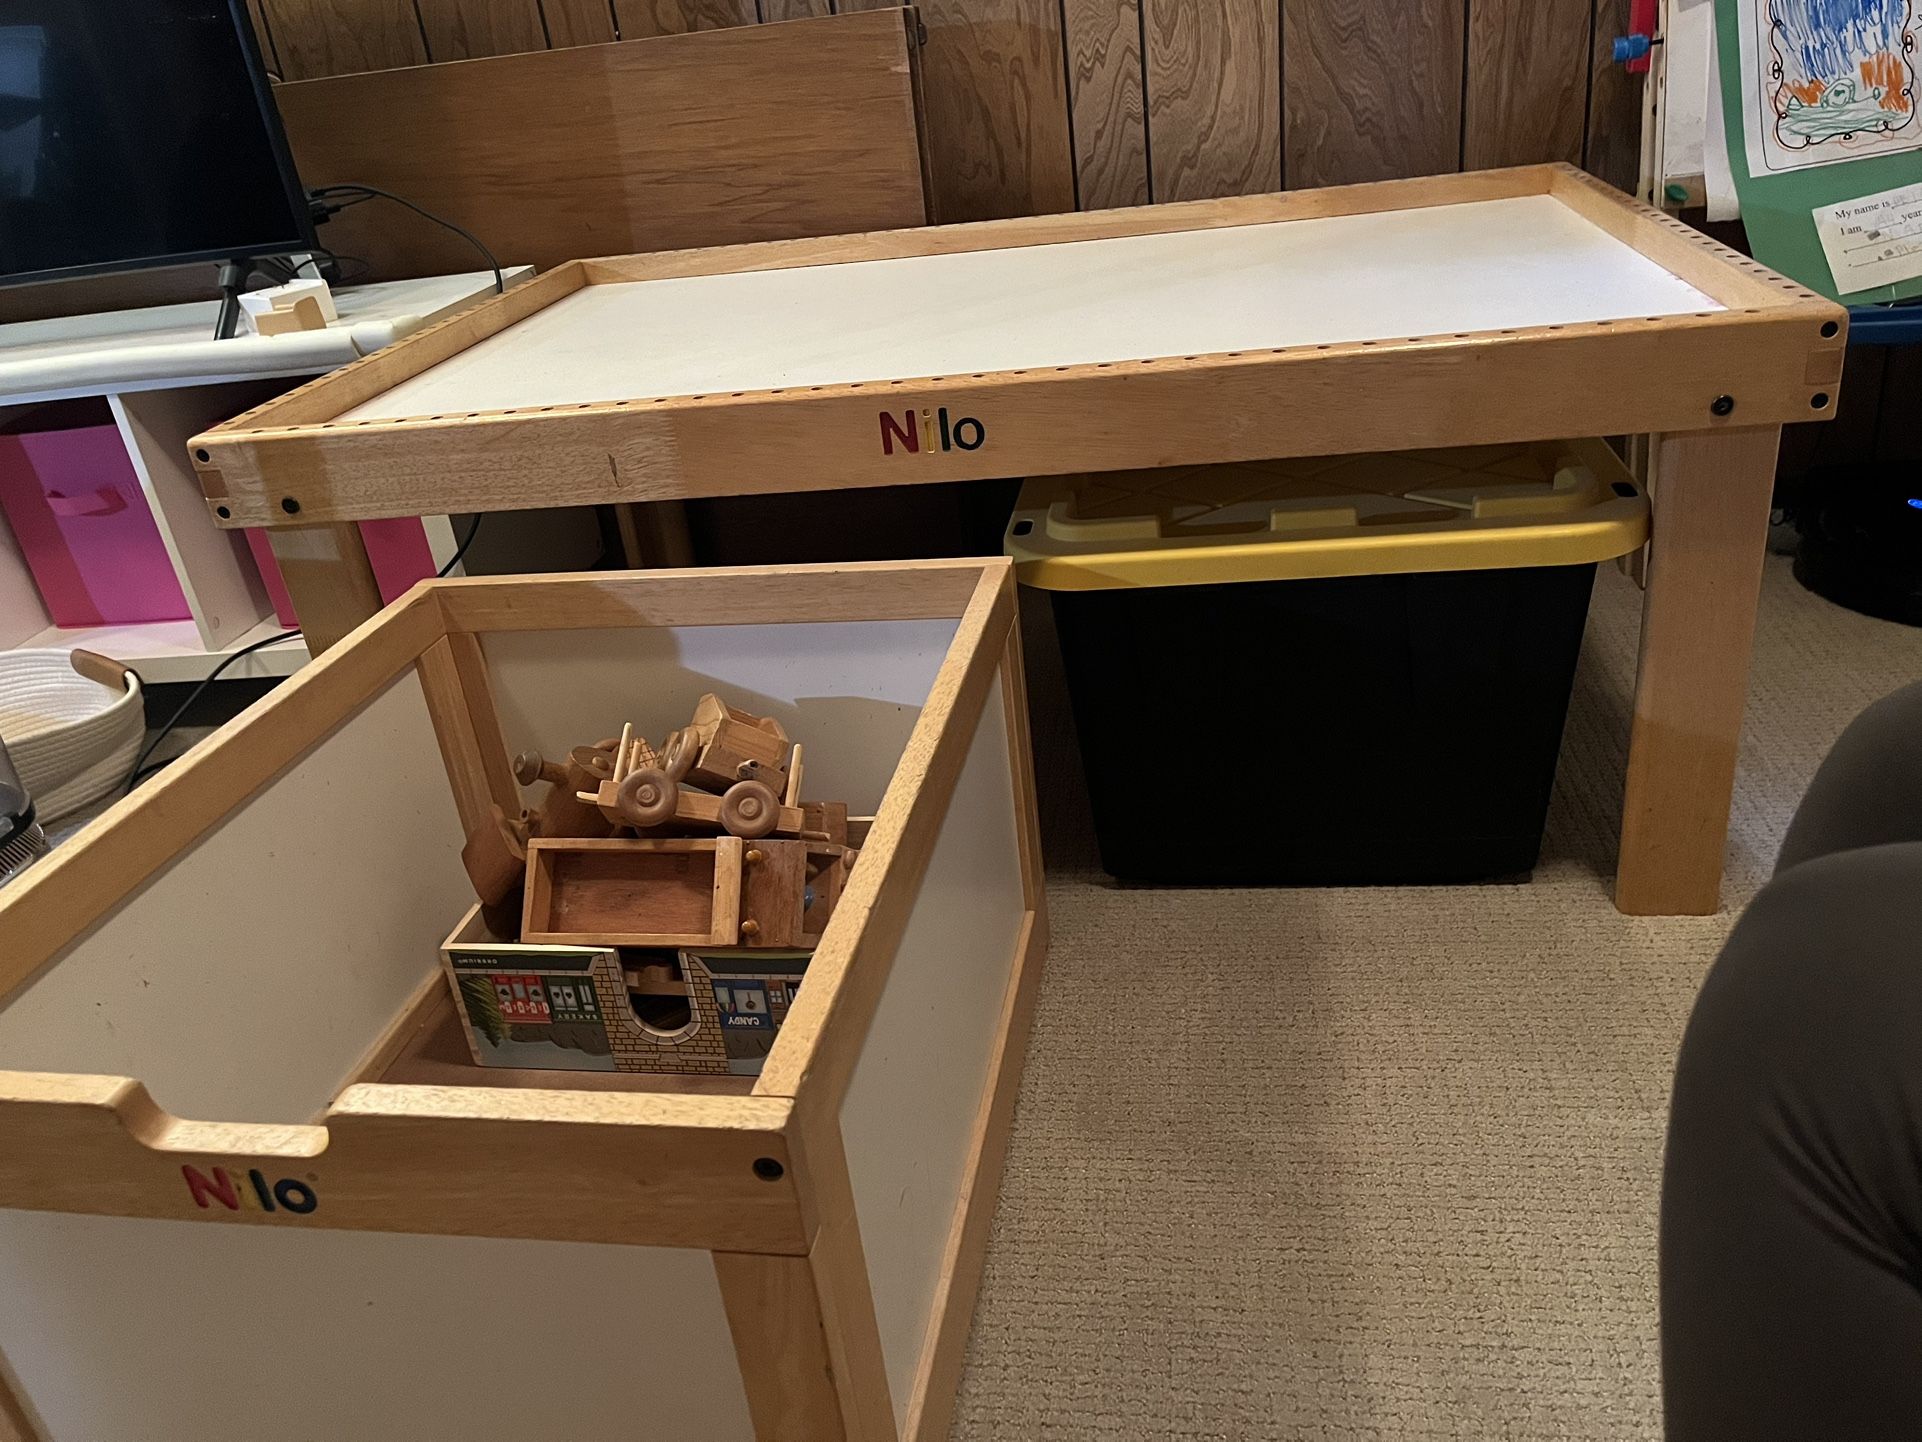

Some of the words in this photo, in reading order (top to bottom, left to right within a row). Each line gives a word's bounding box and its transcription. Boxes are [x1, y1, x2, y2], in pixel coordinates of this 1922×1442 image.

[1835, 209, 1852, 220] My
[1854, 203, 1879, 215] name
[1882, 200, 1891, 208] is
[1847, 225, 1862, 235] am
[879, 407, 985, 455] Nilo
[558, 1013, 598, 1021] BAKERY
[728, 1016, 760, 1026] CANDY
[181, 1164, 318, 1214] Nilo
